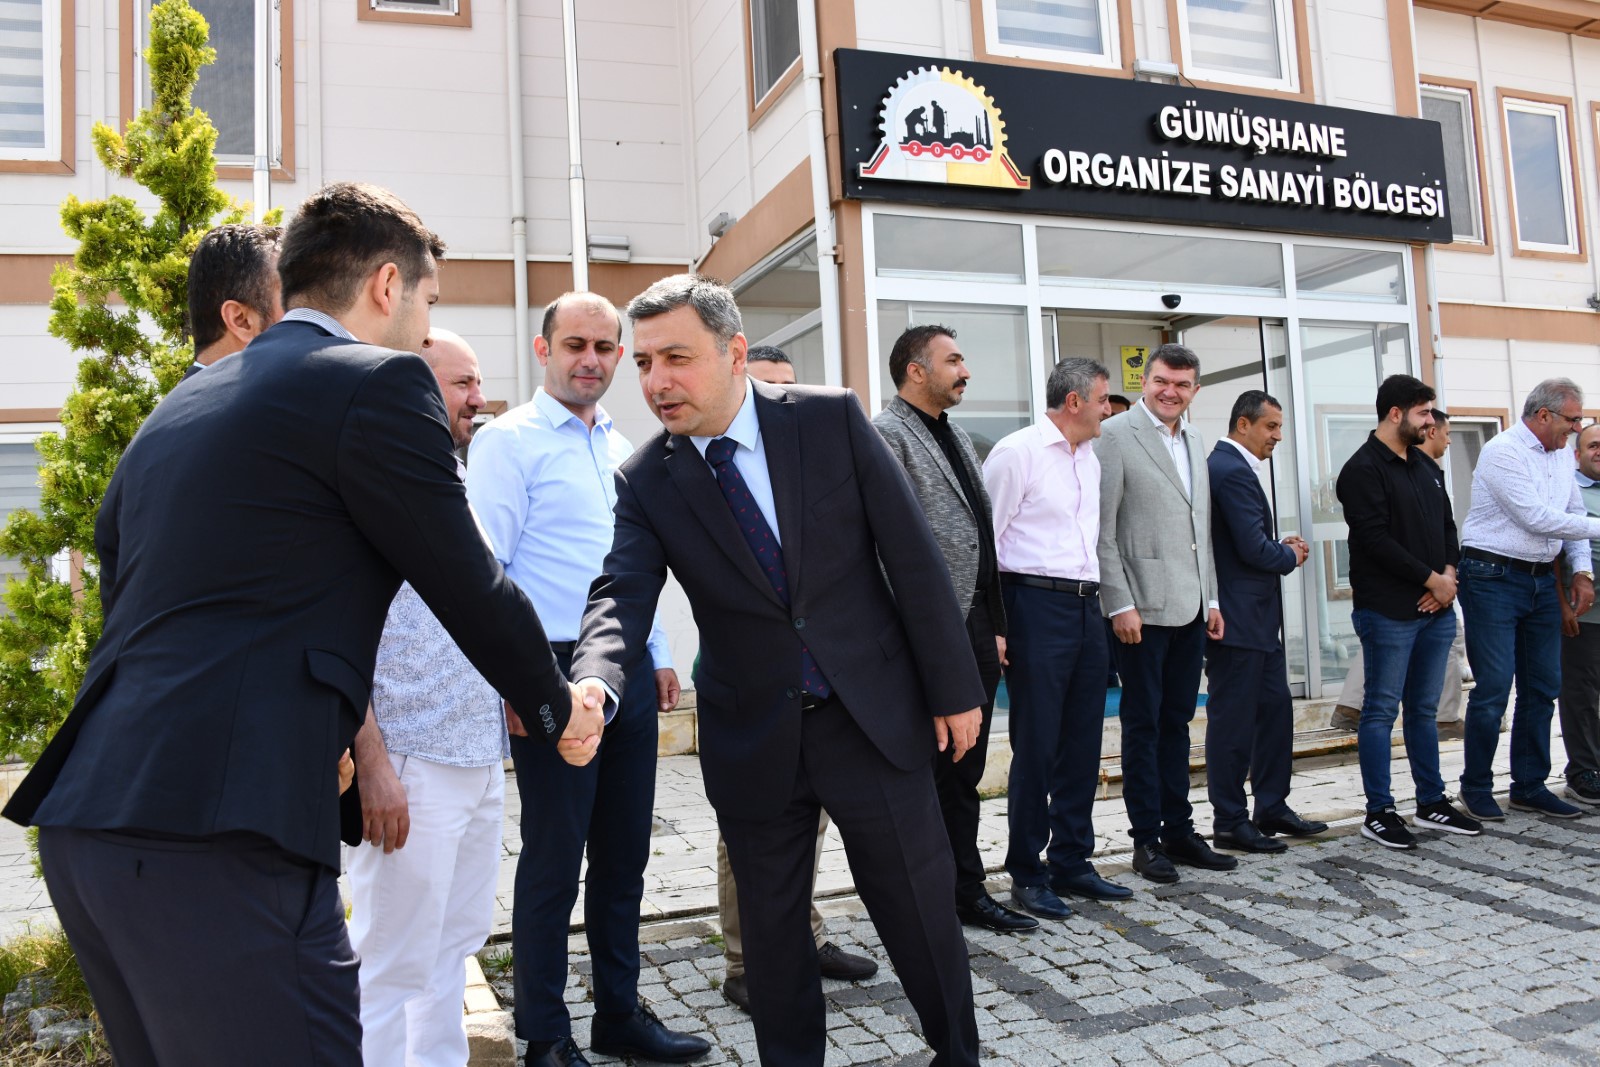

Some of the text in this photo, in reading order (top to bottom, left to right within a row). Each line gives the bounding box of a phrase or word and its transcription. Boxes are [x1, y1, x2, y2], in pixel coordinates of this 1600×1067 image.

[912, 145, 983, 159] 2000
[1159, 100, 1348, 157] GÜMÜŞHANE
[1043, 148, 1446, 218] ORGANİZE SANAYİ BÖLGESİ
